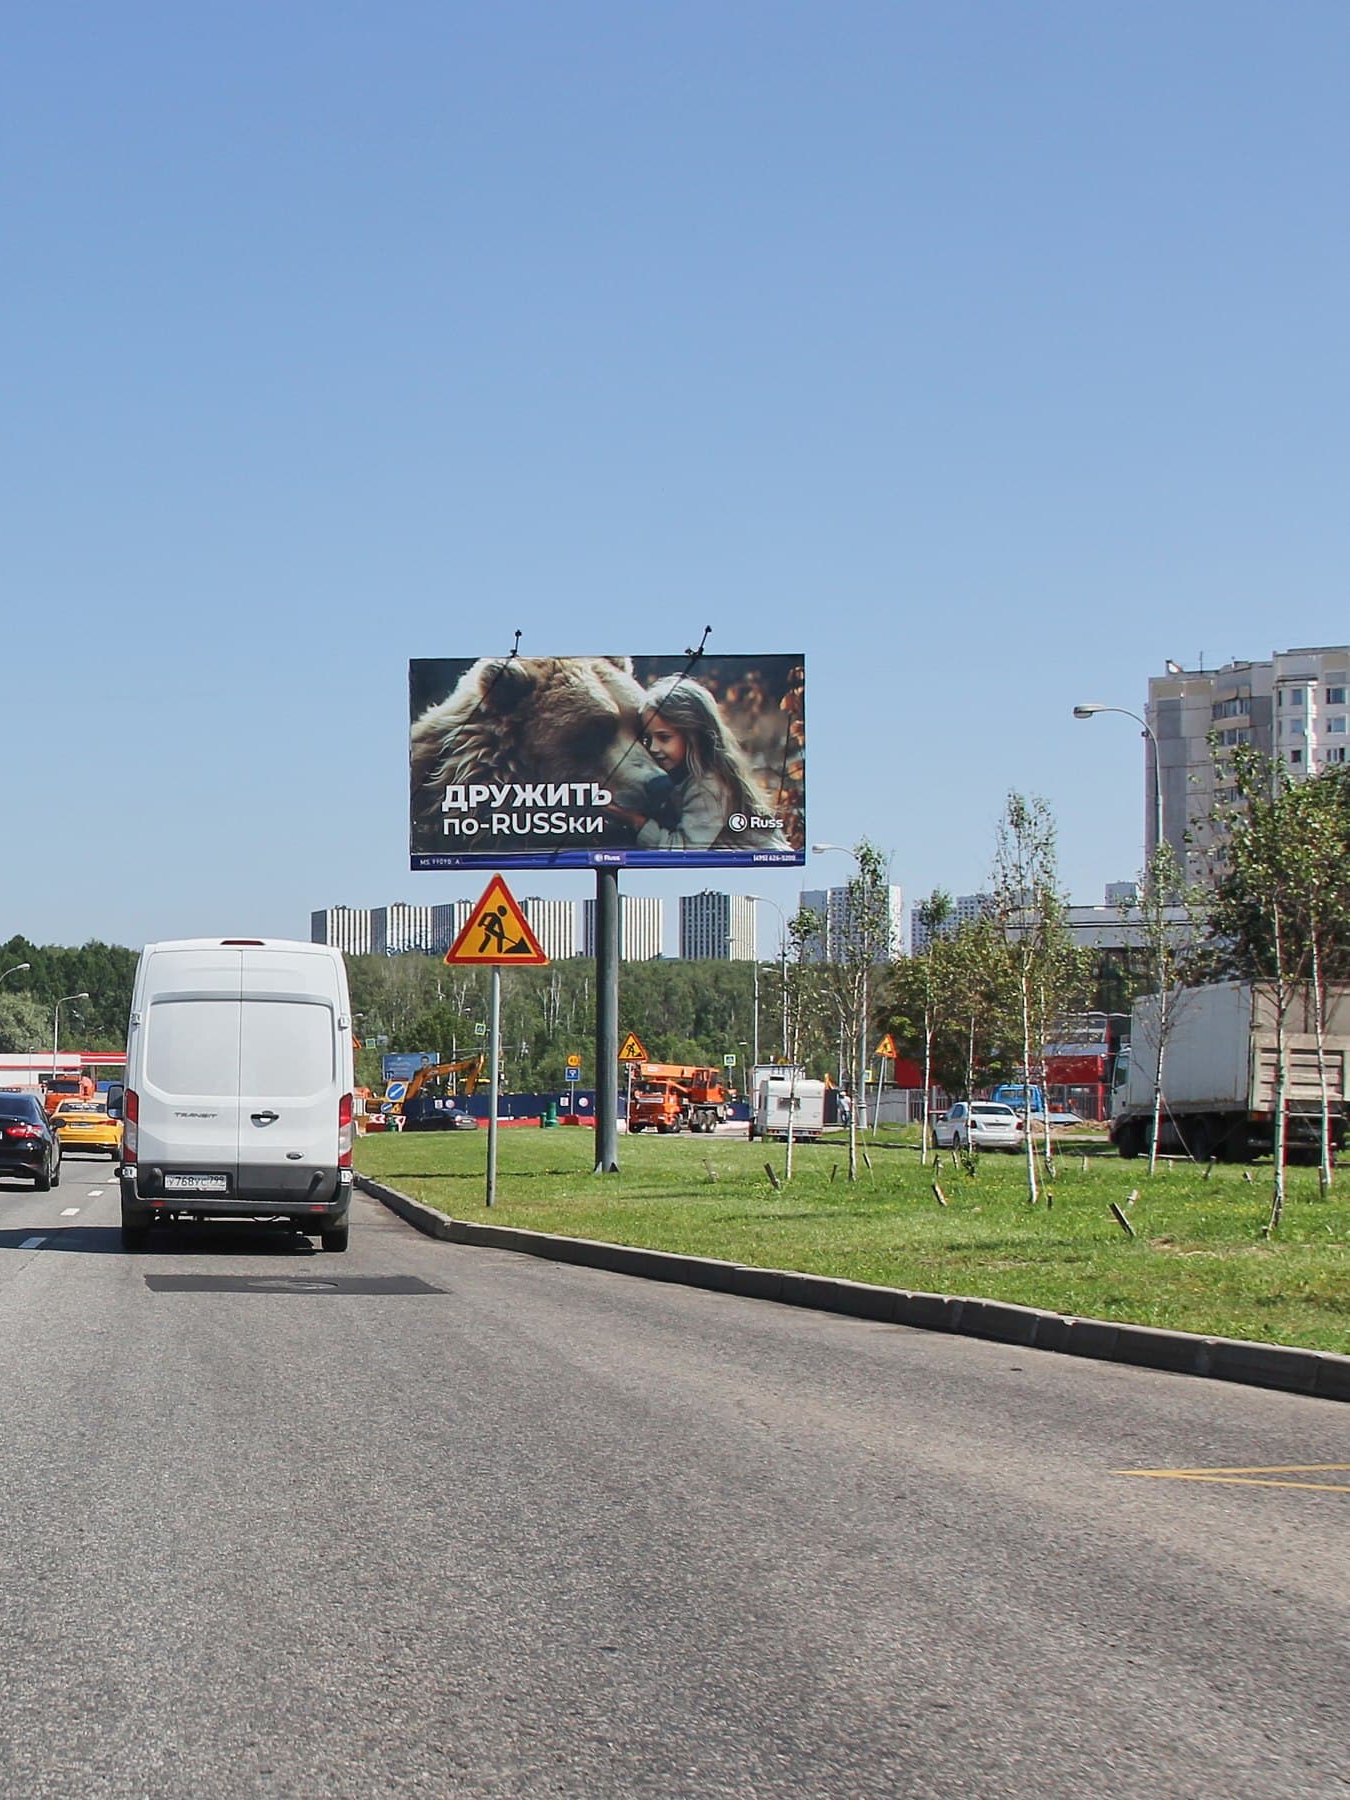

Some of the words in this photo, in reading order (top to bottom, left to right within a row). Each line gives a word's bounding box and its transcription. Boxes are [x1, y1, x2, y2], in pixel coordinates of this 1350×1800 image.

[441, 783, 612, 812] ДРУЖИТЬ
[443, 812, 604, 835] по-RUSSки
[750, 816, 784, 829] Russ
